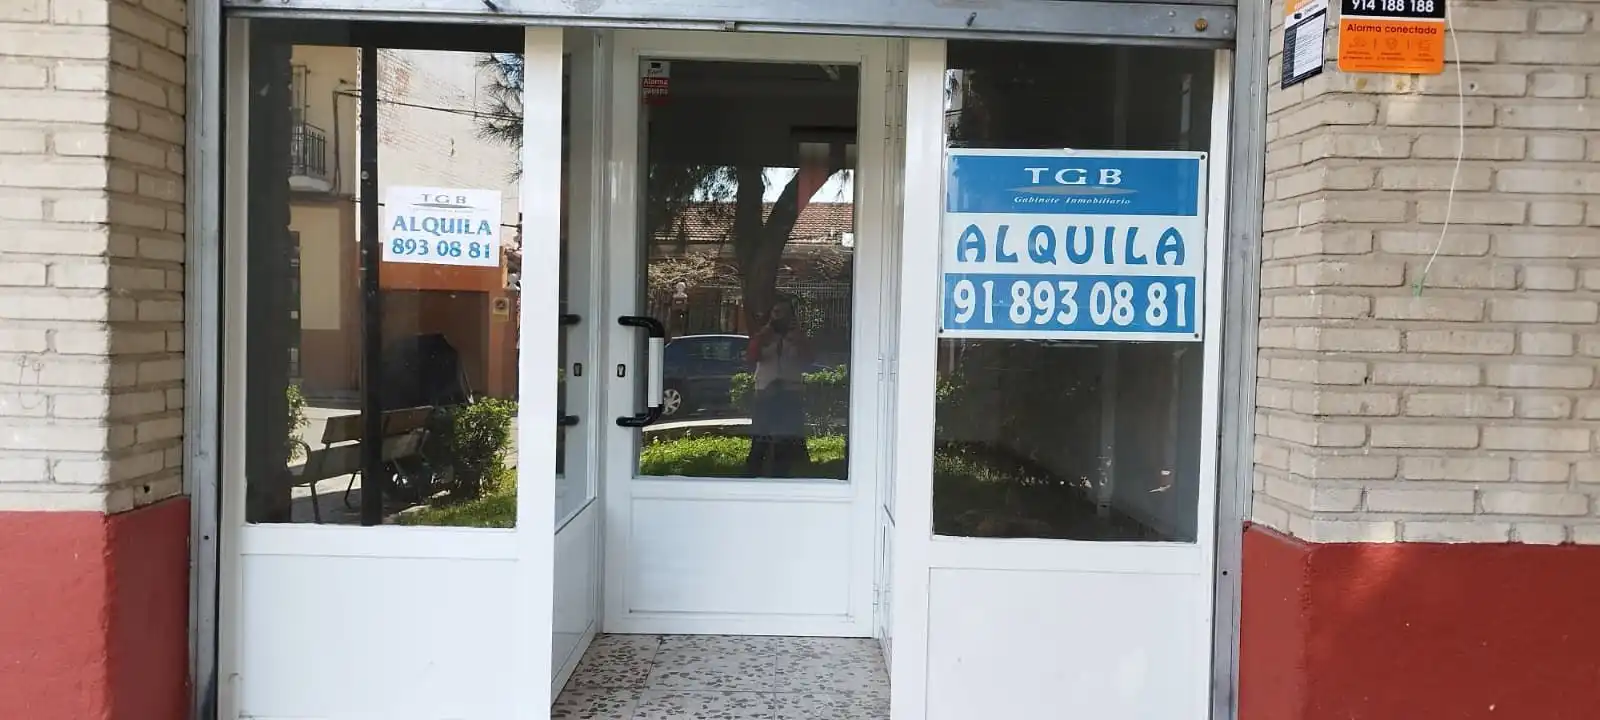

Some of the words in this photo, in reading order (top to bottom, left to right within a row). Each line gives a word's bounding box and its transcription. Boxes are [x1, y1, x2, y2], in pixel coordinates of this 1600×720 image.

[1352, 0, 1376, 11] 914
[1381, 0, 1405, 12] 188
[1411, 0, 1435, 13] 188
[1346, 23, 1382, 33] Alarma
[1385, 24, 1438, 35] conectada
[1024, 167, 1122, 185] TGB
[421, 193, 467, 204] TGB
[1014, 196, 1060, 205] Gabinete
[1065, 196, 1132, 206] Inmobiliario
[392, 215, 492, 236] ALQUILA
[392, 238, 429, 256] 893
[436, 240, 462, 258] 08
[468, 241, 490, 259] 81
[956, 223, 1186, 266] ALQUILA
[953, 279, 994, 324] 91
[1009, 280, 1079, 325] 893
[1089, 281, 1135, 326] 08
[1145, 282, 1187, 327] 81
